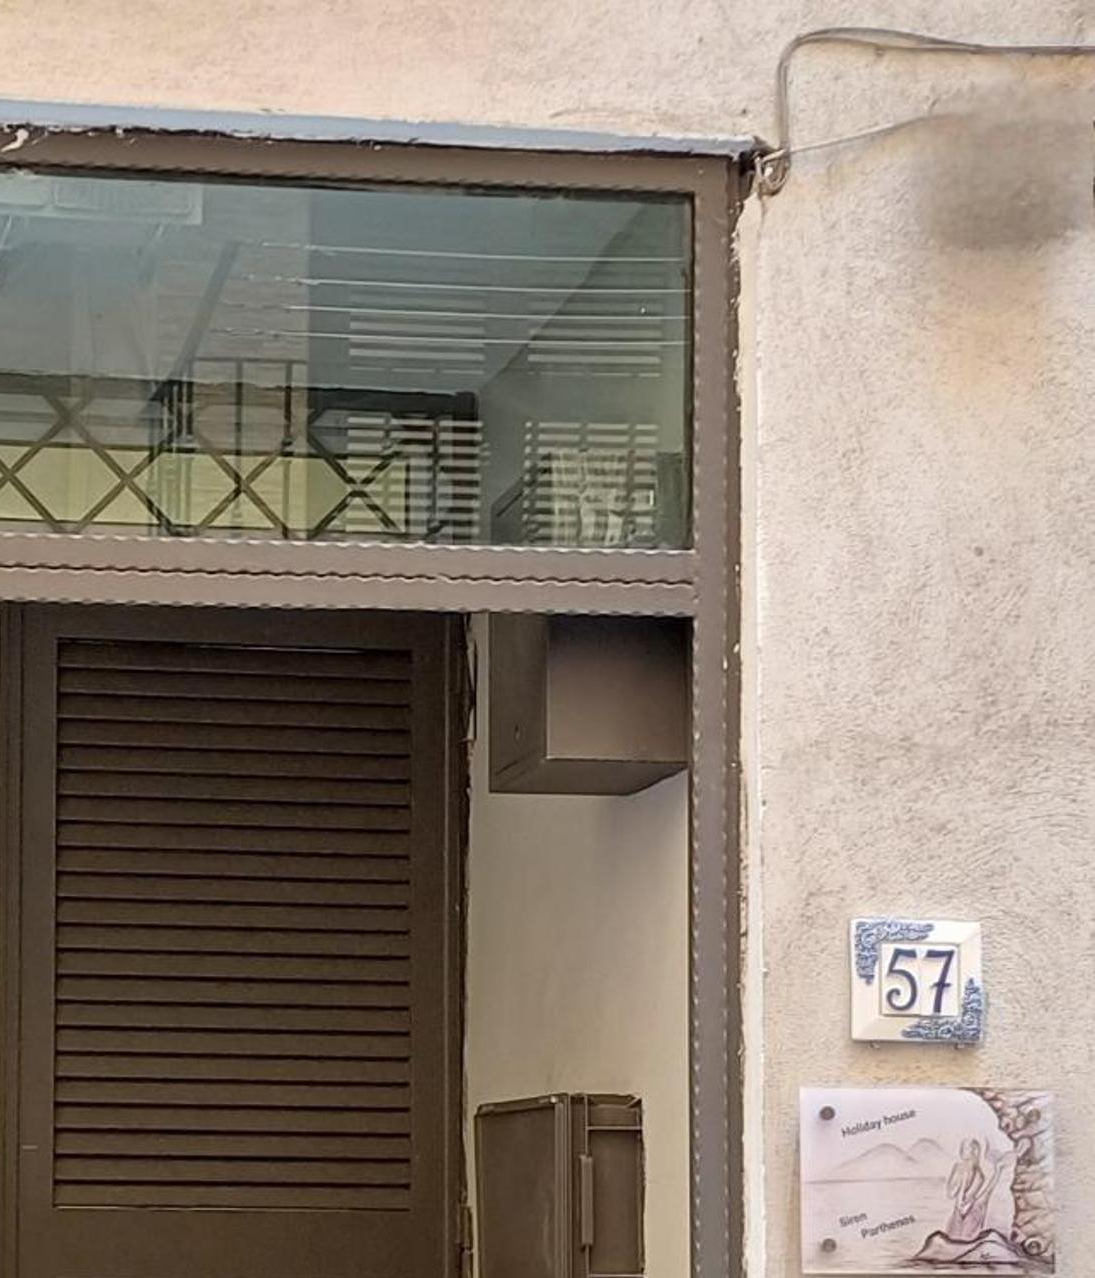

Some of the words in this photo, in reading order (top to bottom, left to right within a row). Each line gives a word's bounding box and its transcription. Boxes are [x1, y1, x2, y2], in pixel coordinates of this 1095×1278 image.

[886, 948, 955, 1013] 57
[840, 1119, 881, 1138] Holiday
[882, 1108, 916, 1125] house
[839, 1212, 867, 1228] Siren
